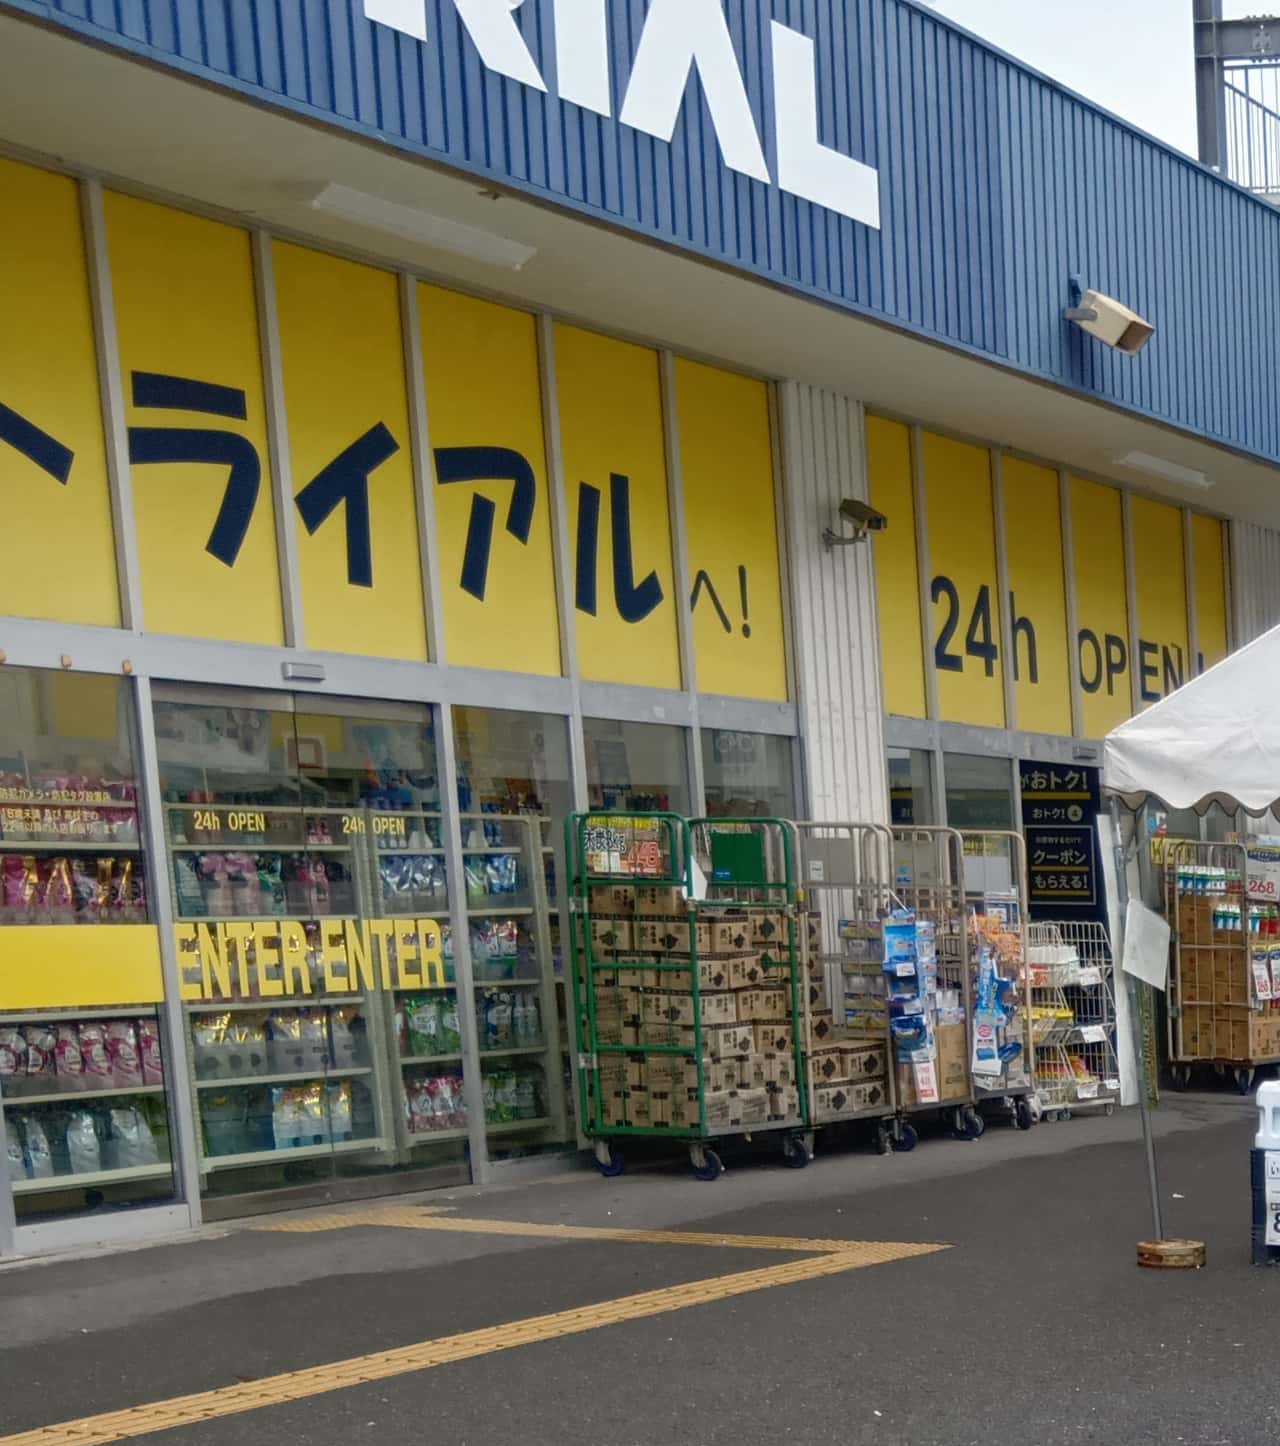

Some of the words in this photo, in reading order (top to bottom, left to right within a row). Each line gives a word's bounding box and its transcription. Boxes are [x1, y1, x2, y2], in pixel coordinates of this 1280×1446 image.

[930, 575, 1039, 684] 24h
[194, 811, 220, 830] 24h
[228, 812, 265, 832] OPEN
[342, 815, 365, 833] 24h
[372, 816, 405, 835] OPEN
[1033, 850, 1087, 865] クーポン
[1033, 874, 1088, 889] もらえる!
[1248, 880, 1275, 895] 268
[174, 920, 313, 1000] ENTER
[321, 919, 446, 993] ENTER
